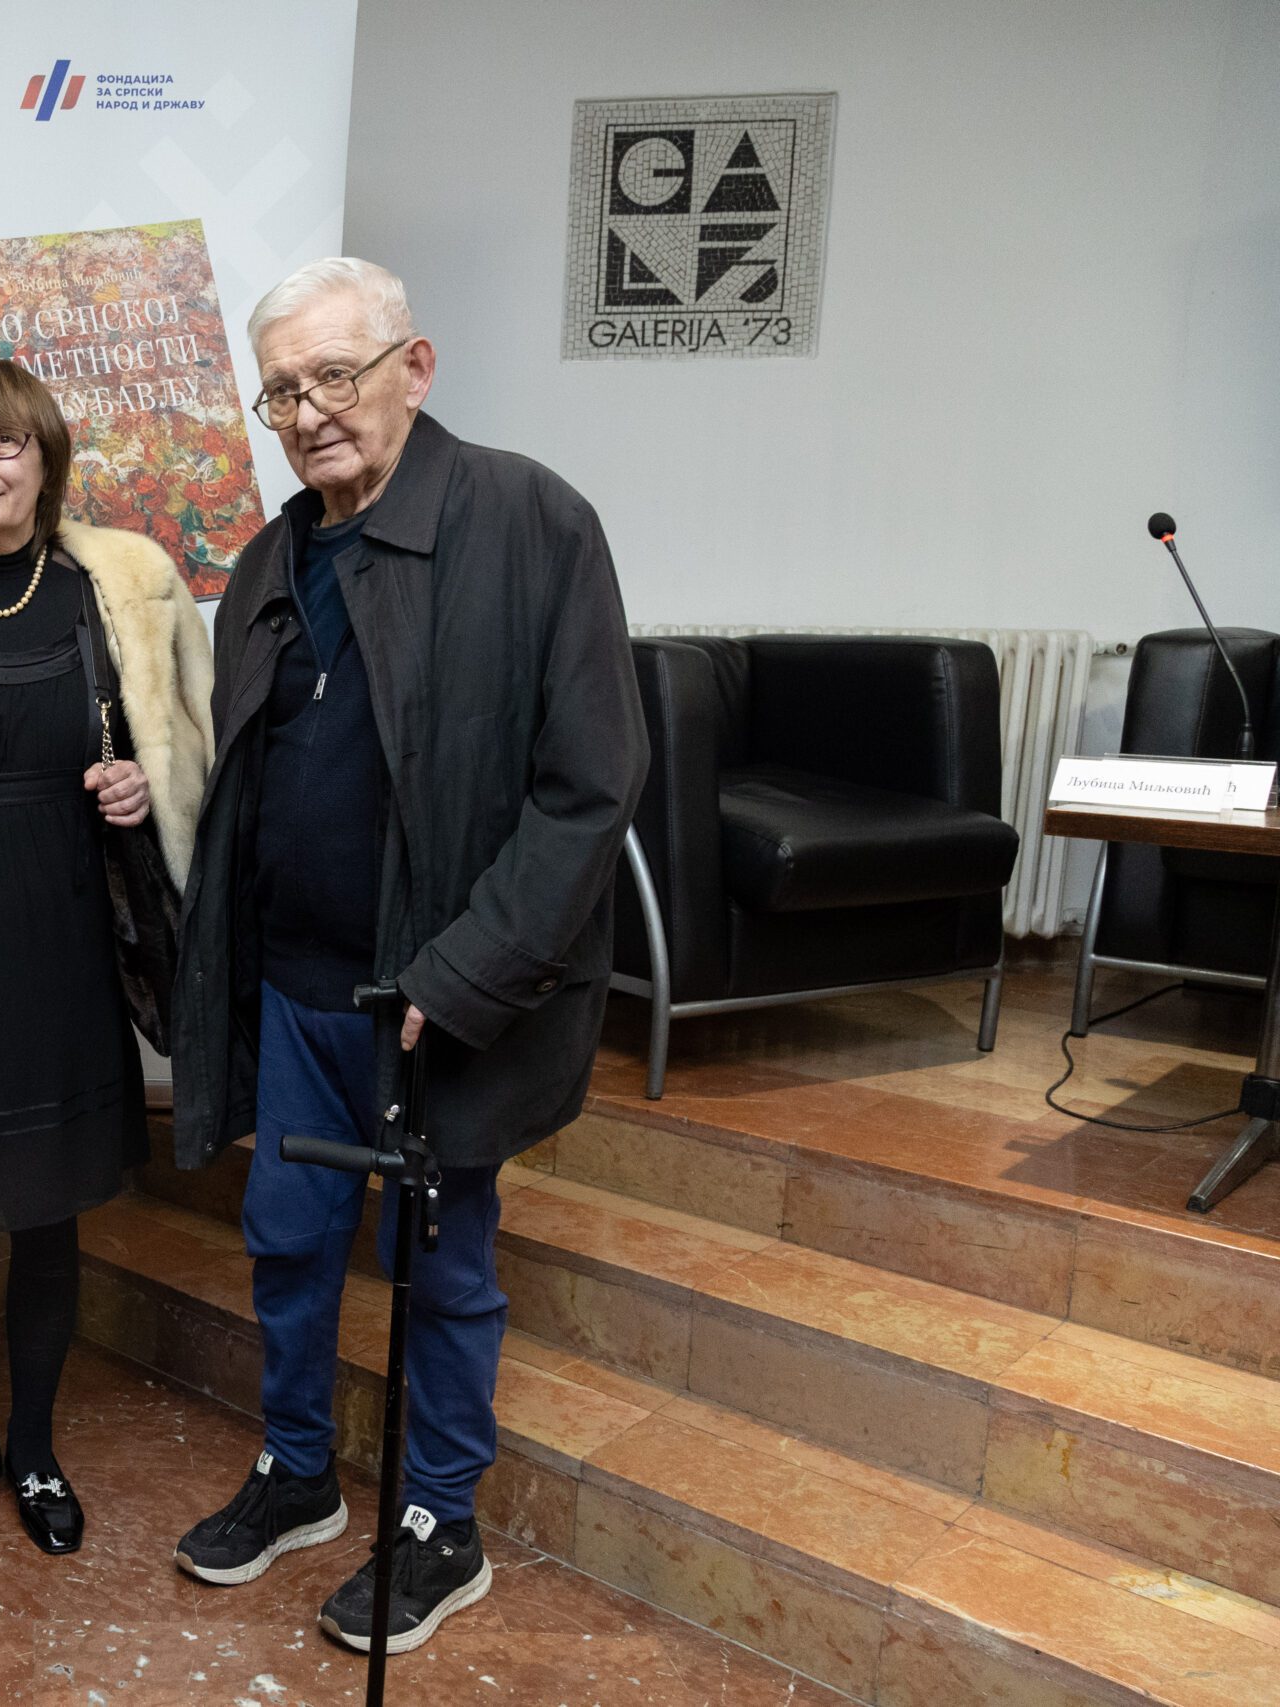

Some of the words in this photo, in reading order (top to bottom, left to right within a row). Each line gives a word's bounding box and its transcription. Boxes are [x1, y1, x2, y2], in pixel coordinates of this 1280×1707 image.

[96, 74, 174, 84] ФОНДАЦИЈА
[96, 87, 112, 97] ЗА
[115, 88, 163, 97] СРПСКИ
[96, 100, 138, 111] НАРОД
[142, 101, 150, 110] И
[153, 100, 206, 111] ДРЖАВУ
[1, 314, 23, 343] О
[34, 295, 180, 339] СРПСКОЈ
[588, 317, 727, 352] GALERIJA
[0, 334, 201, 382] МЕТНОСТИ
[1067, 776, 1124, 791] Љубица
[1129, 780, 1211, 796] Миљковић
[410, 1510, 429, 1531] 82
